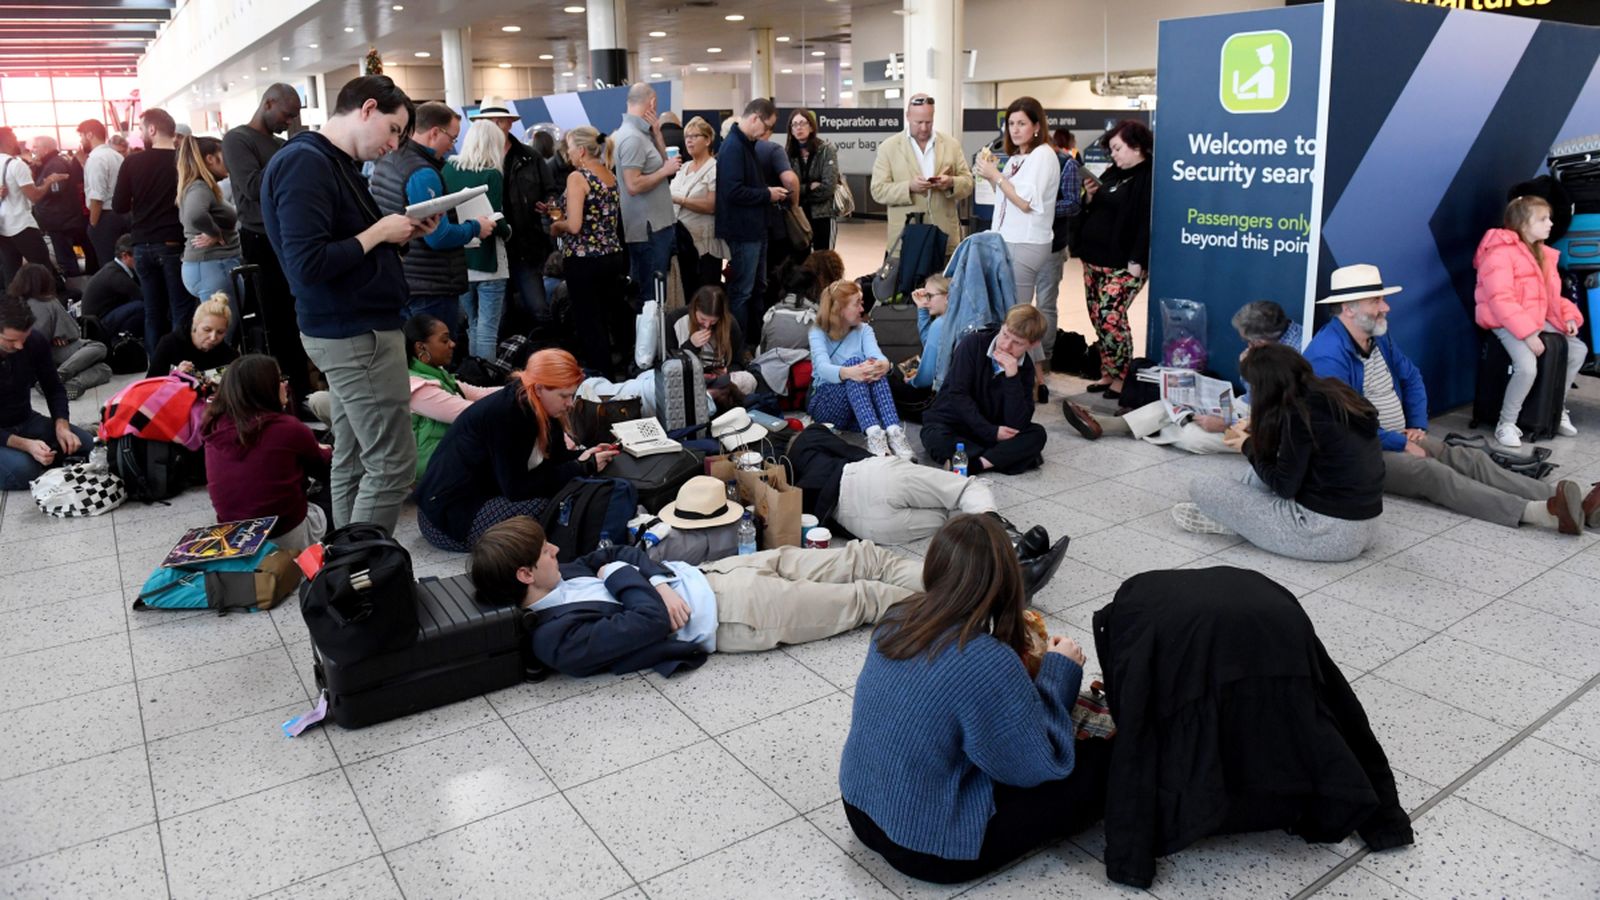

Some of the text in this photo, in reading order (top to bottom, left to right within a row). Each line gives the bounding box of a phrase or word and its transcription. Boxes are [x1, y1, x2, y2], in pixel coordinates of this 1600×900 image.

[820, 116, 899, 130] Preparation area
[1059, 118, 1077, 126] area
[858, 139, 877, 151] bag
[1188, 132, 1317, 155] Welcome to
[1172, 160, 1315, 189] Security sear
[1187, 208, 1312, 236] Passengers only
[1181, 228, 1310, 257] beyond this poin
